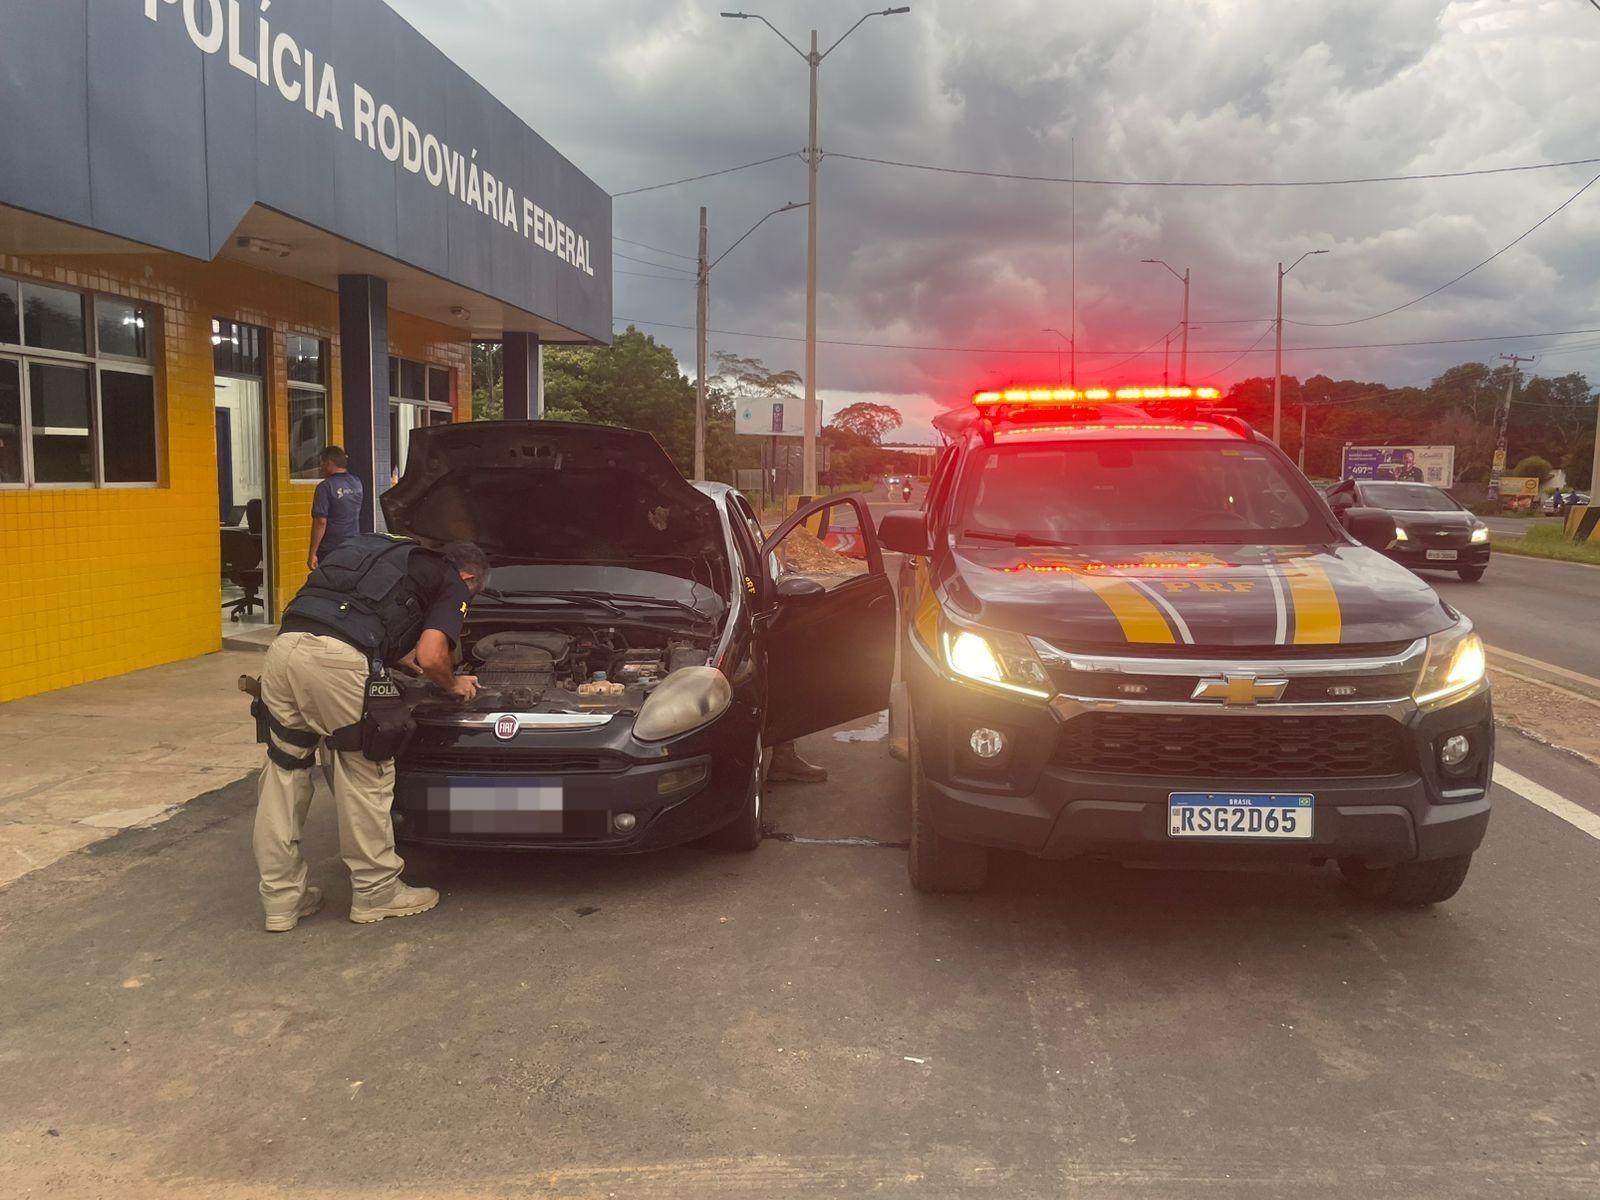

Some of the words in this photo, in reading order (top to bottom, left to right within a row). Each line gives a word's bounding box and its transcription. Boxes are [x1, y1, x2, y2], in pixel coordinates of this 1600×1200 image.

[145, 0, 343, 130] OLÍCIA
[354, 83, 518, 232] RODOVIÁRIA
[524, 197, 594, 277] FEDERAL
[1161, 581, 1255, 592] PRF
[500, 721, 514, 733] FIAT
[1181, 807, 1296, 833] RSG2D65
